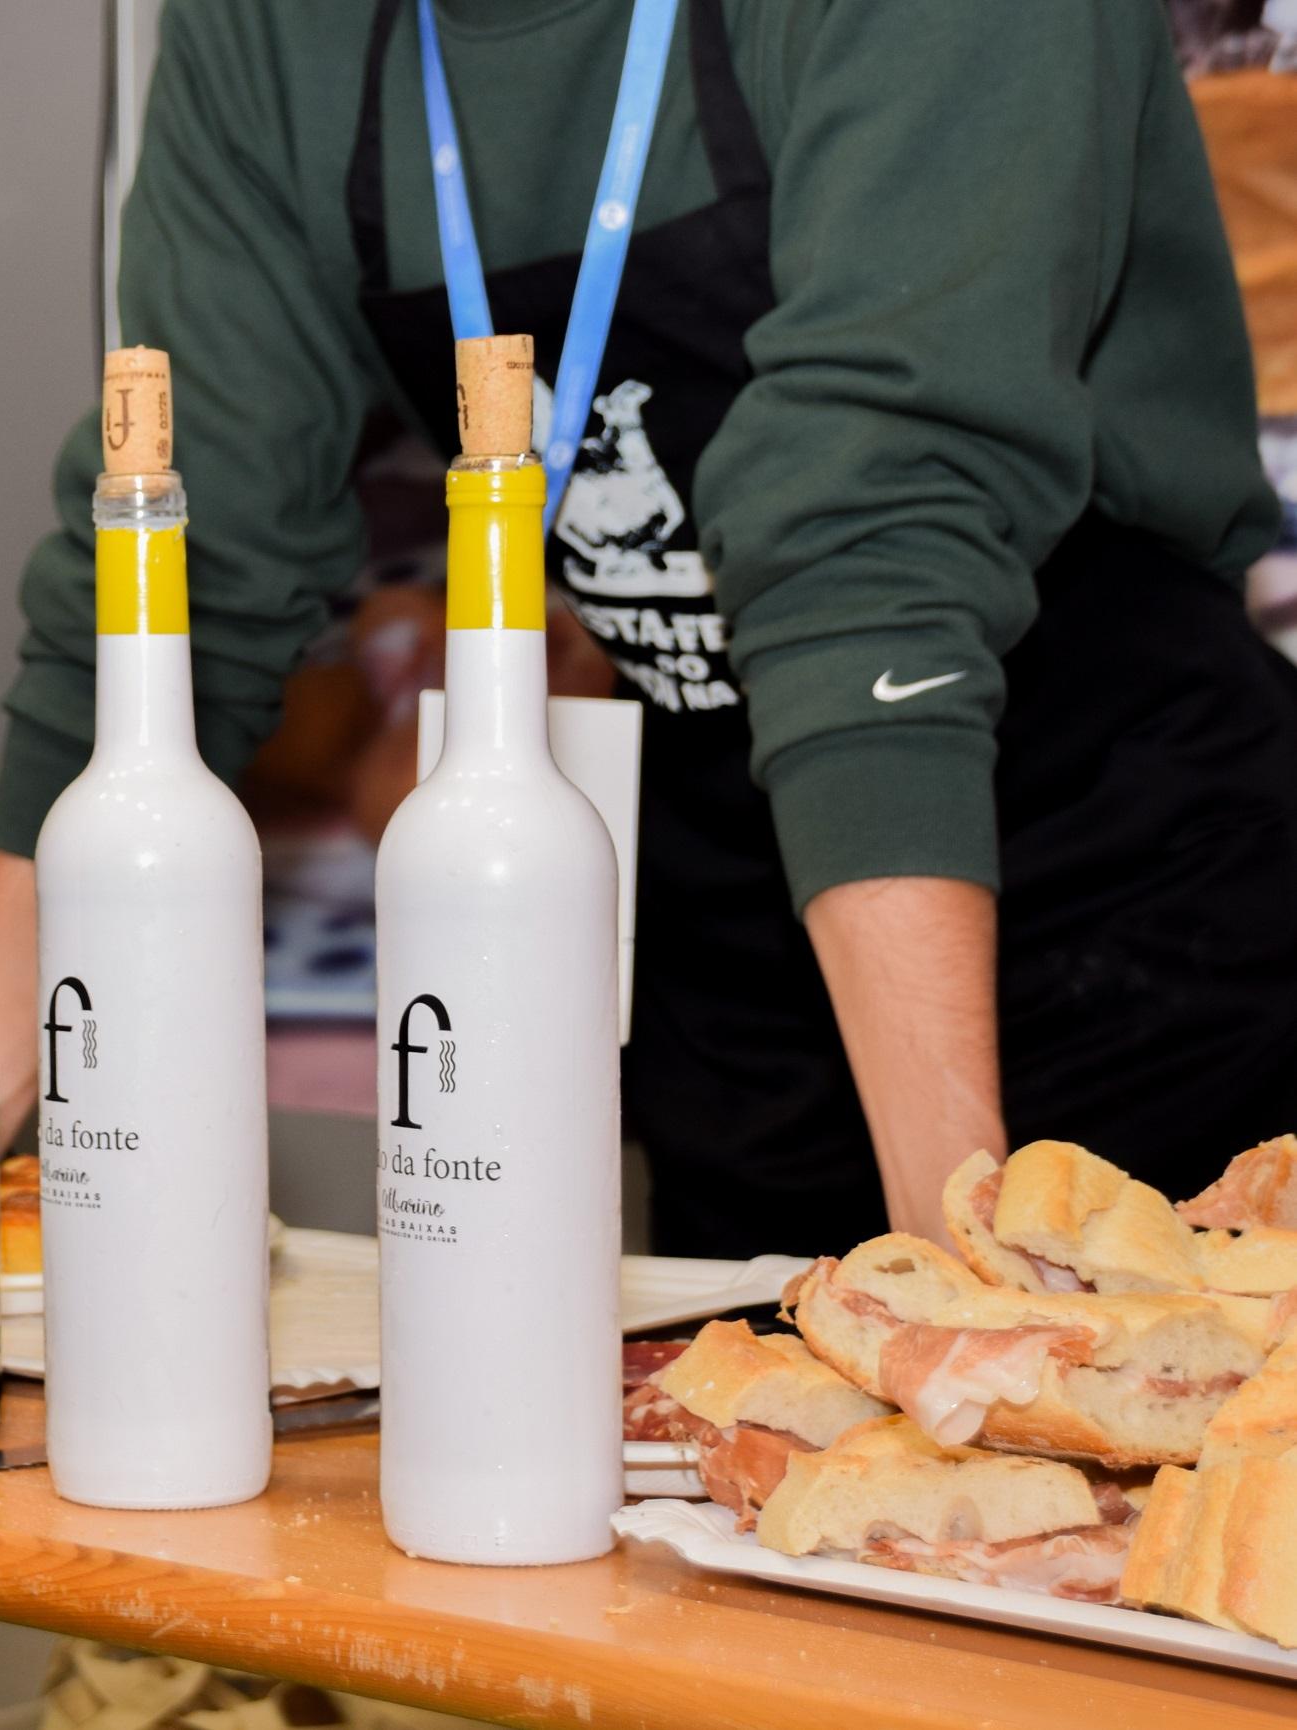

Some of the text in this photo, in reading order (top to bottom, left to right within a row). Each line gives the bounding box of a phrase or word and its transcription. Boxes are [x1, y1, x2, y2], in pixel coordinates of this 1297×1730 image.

[45, 1117, 140, 1151] da fonte
[392, 1144, 415, 1176] da
[423, 1147, 502, 1181] fonte
[400, 1220, 458, 1235] BAIXAS
